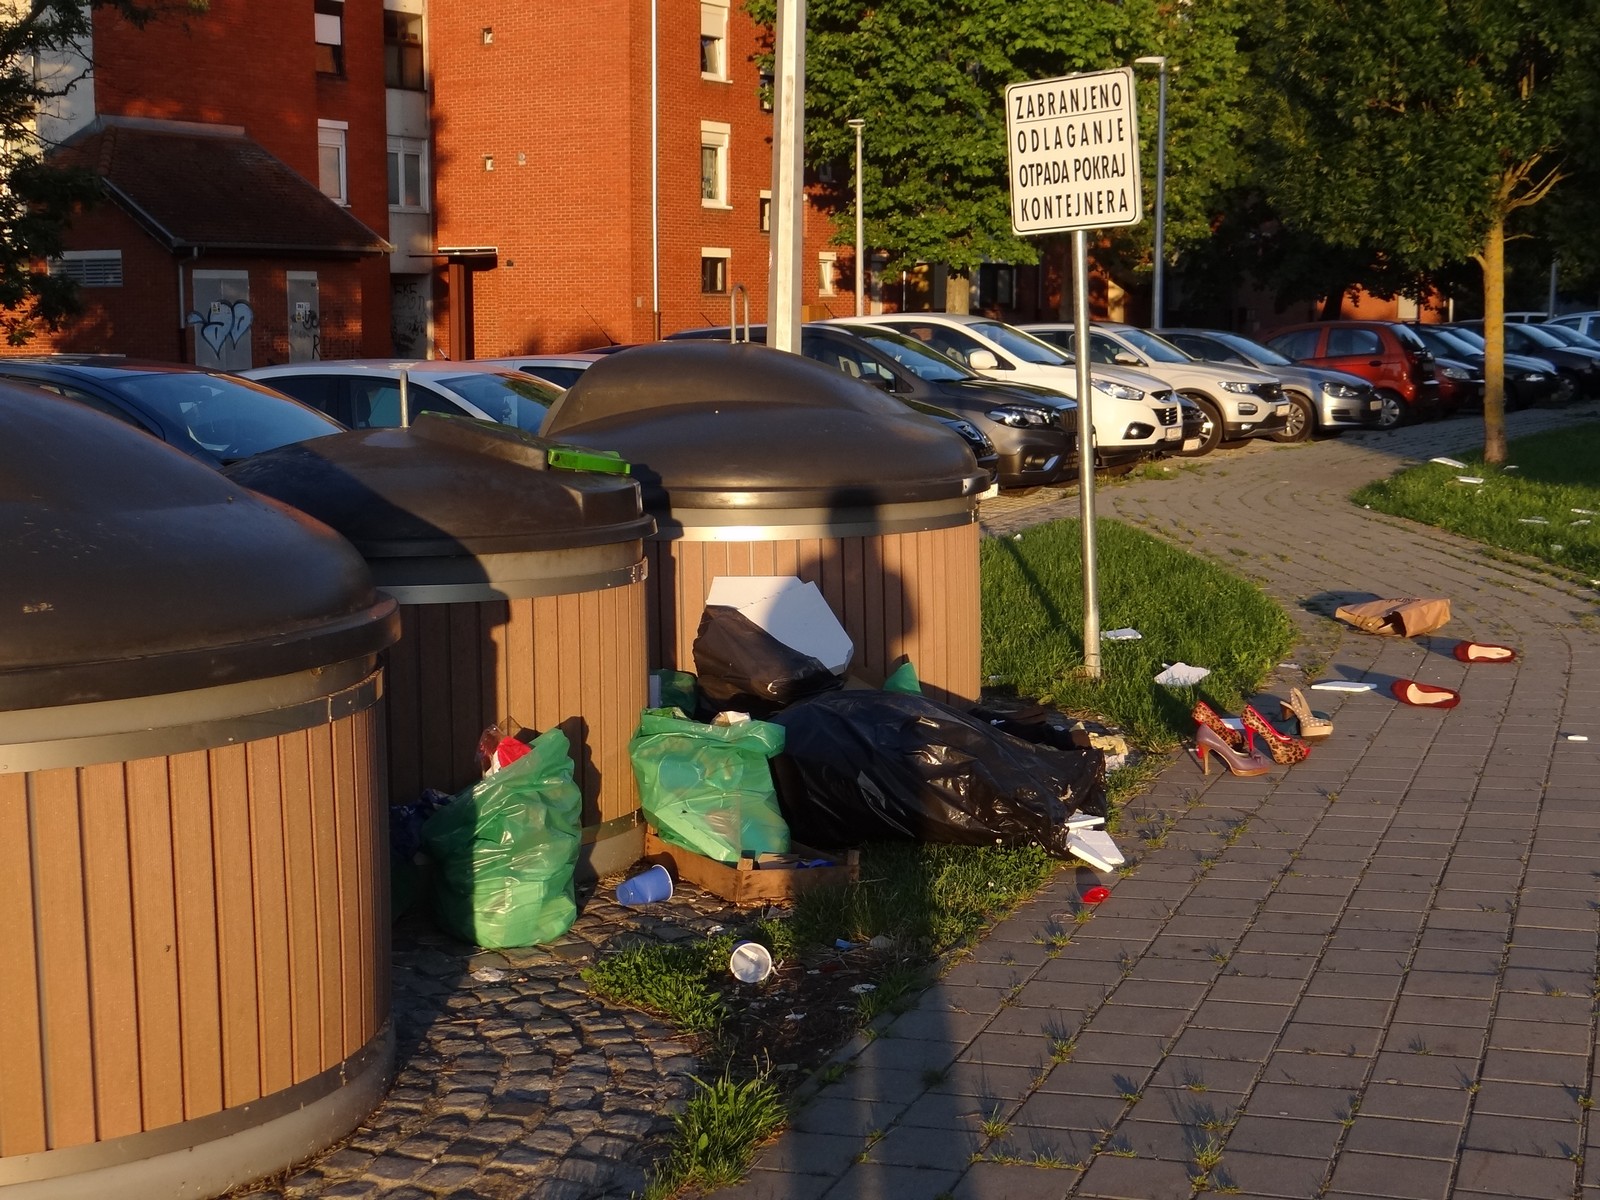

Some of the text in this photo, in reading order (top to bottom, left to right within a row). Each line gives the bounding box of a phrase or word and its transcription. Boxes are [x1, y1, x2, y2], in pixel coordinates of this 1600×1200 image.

[1015, 82, 1122, 120] ZABRANJENO
[1017, 118, 1124, 154] ODLAGANJE
[1019, 153, 1126, 188] OTPADA POKRAJ
[1020, 188, 1128, 222] KONTEJNERA
